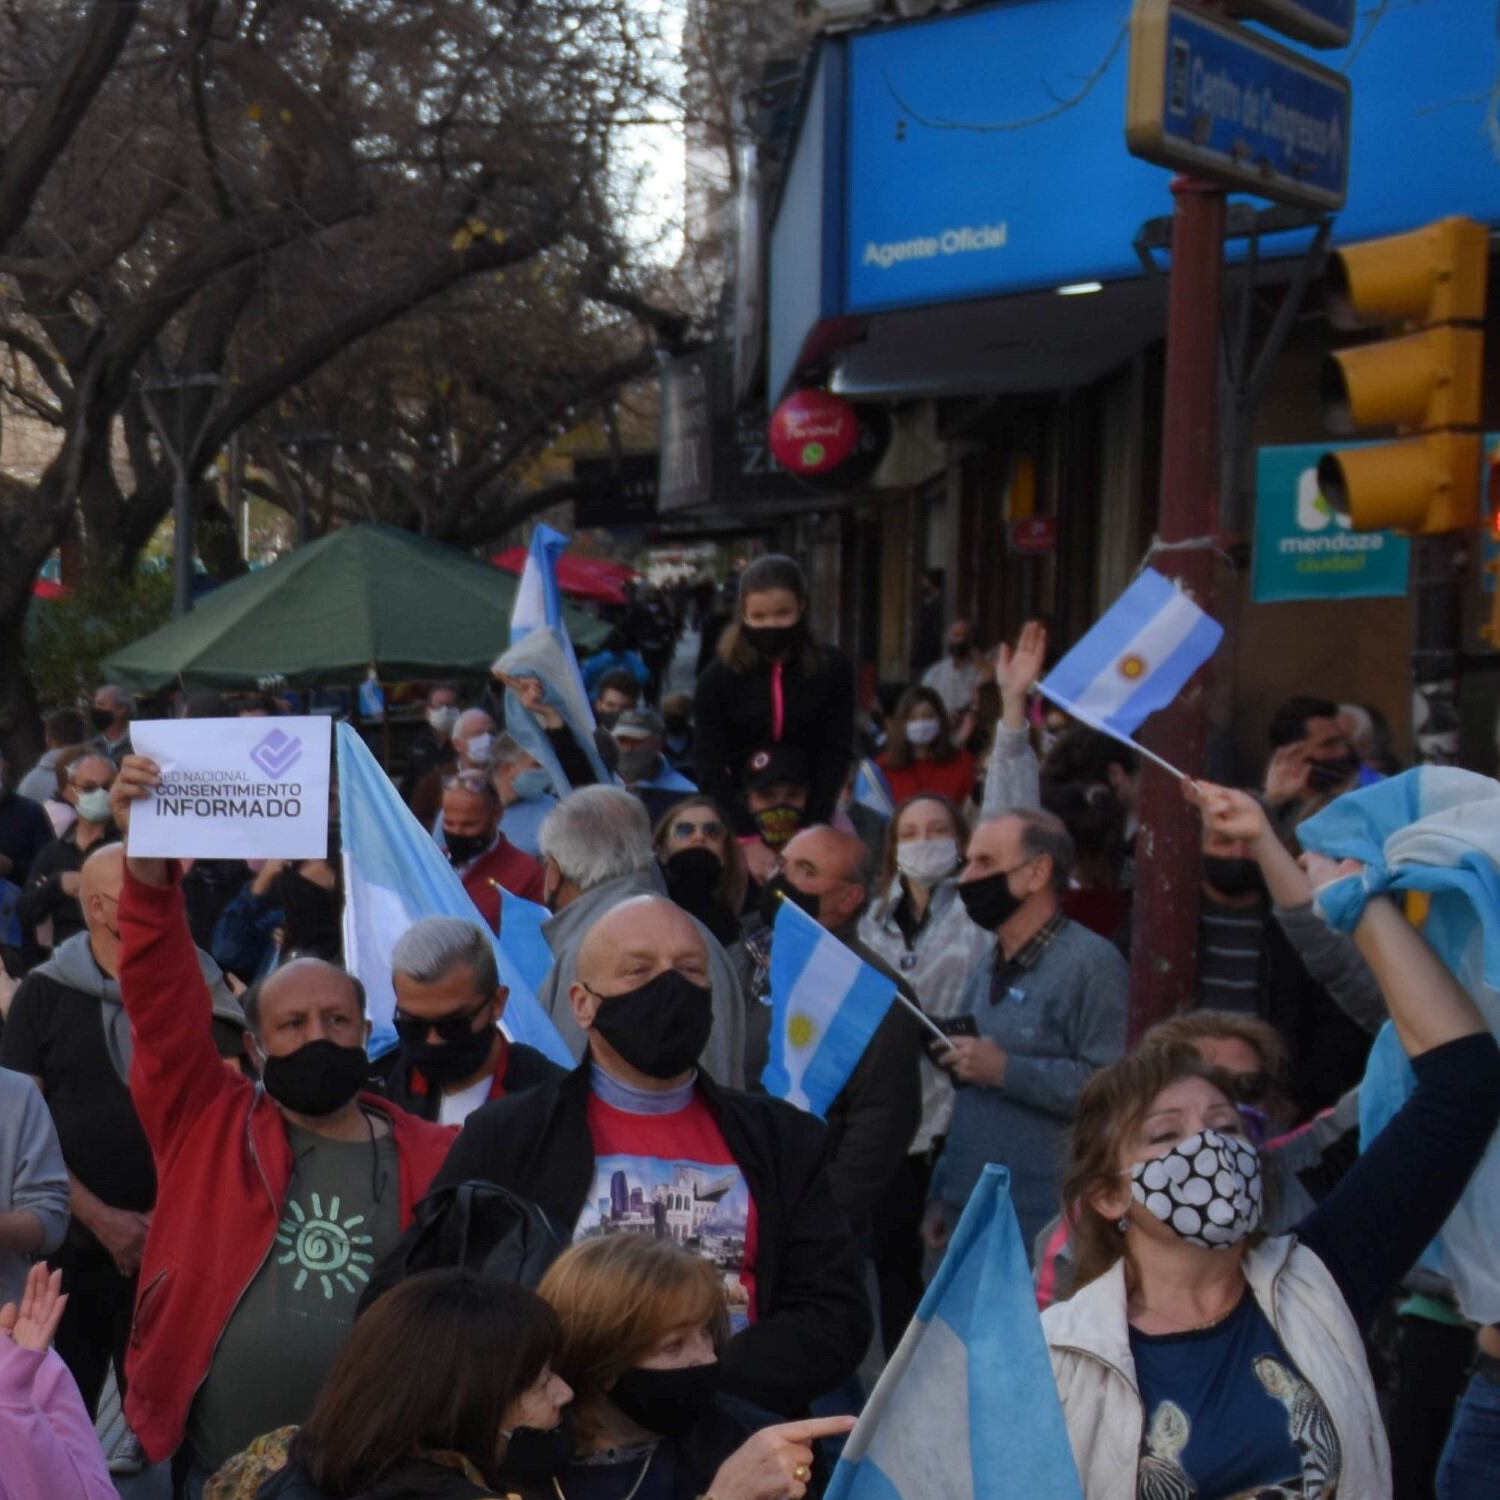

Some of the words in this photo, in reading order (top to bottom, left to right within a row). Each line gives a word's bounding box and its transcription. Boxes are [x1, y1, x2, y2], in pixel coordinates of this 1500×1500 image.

[1192, 56, 1240, 122] Centro
[1243, 81, 1259, 131] de
[864, 238, 937, 269] Agente
[940, 221, 1008, 256] Oficial
[1280, 533, 1384, 553] mendoza
[183, 770, 250, 783] NACIONAL
[156, 783, 301, 797] CONSENTIMIENTO
[156, 798, 302, 818] INFORMADO
